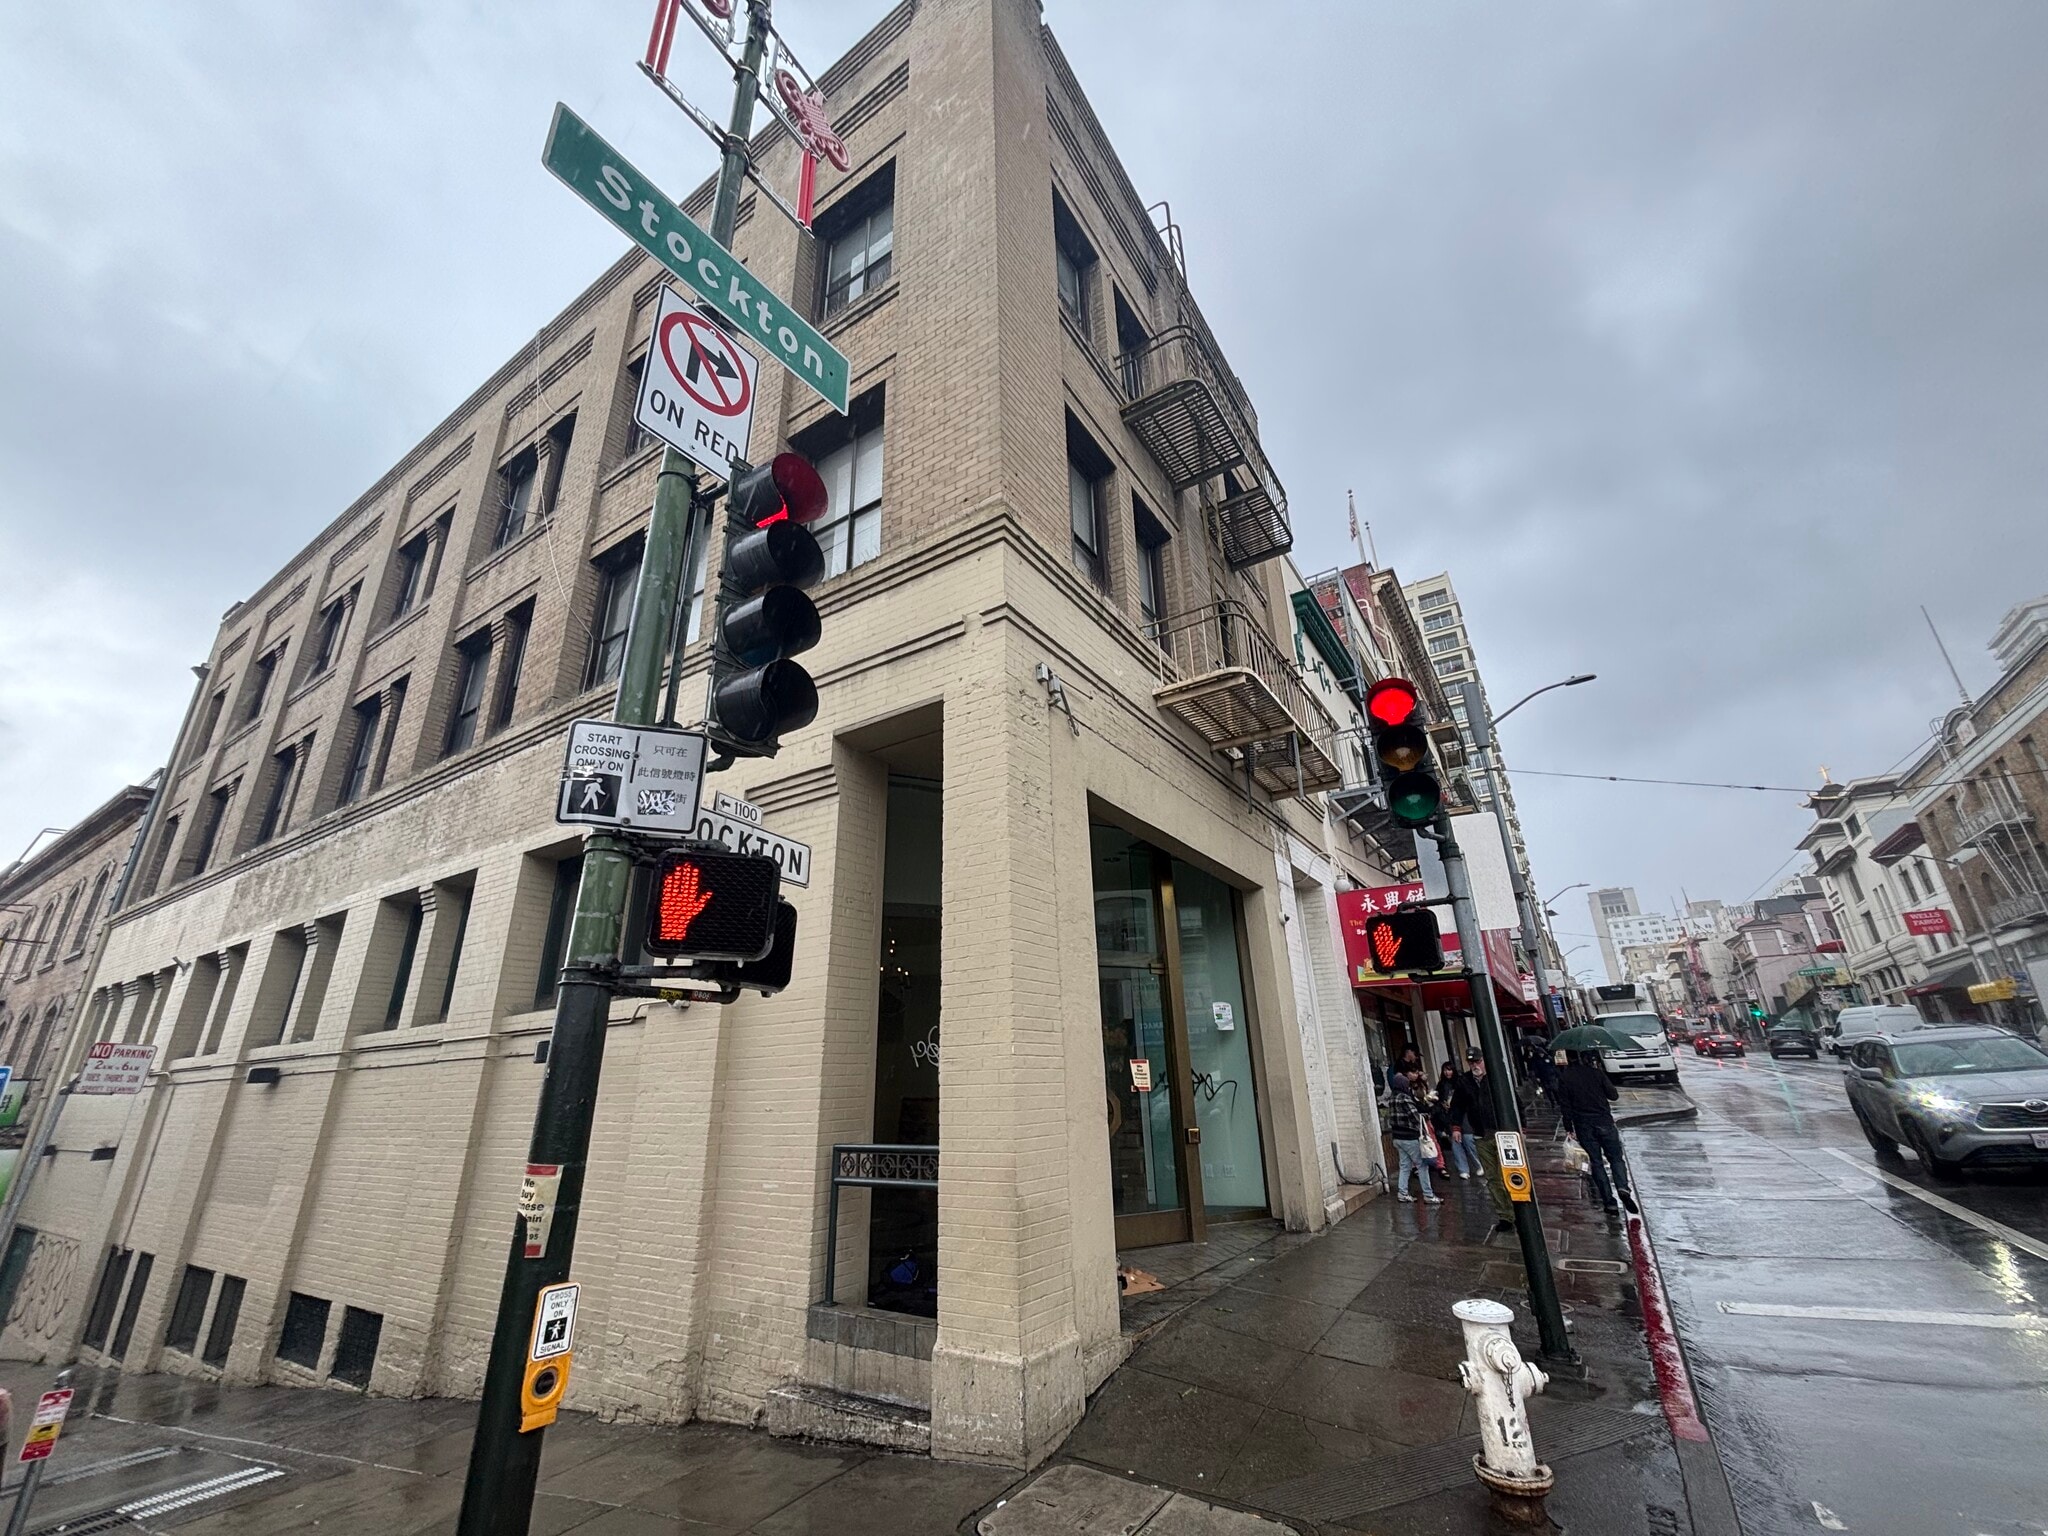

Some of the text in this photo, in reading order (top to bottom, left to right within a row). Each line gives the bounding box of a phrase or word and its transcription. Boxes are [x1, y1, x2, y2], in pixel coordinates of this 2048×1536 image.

[595, 164, 823, 379] Stockton
[649, 389, 739, 465] ON RED
[587, 733, 623, 745] START
[574, 744, 631, 760] CROSSING
[653, 745, 689, 758] 只可在
[576, 758, 624, 772] ONLY ON
[734, 801, 758, 822] 1100
[1909, 911, 1942, 920] WELLS
[1912, 917, 1944, 927] FARGO
[92, 1044, 153, 1060] NO PARKING
[550, 1290, 573, 1301] CROSS
[551, 1300, 569, 1310] ONLY
[554, 1310, 564, 1318] ON
[540, 1342, 566, 1354] SIGNAL
